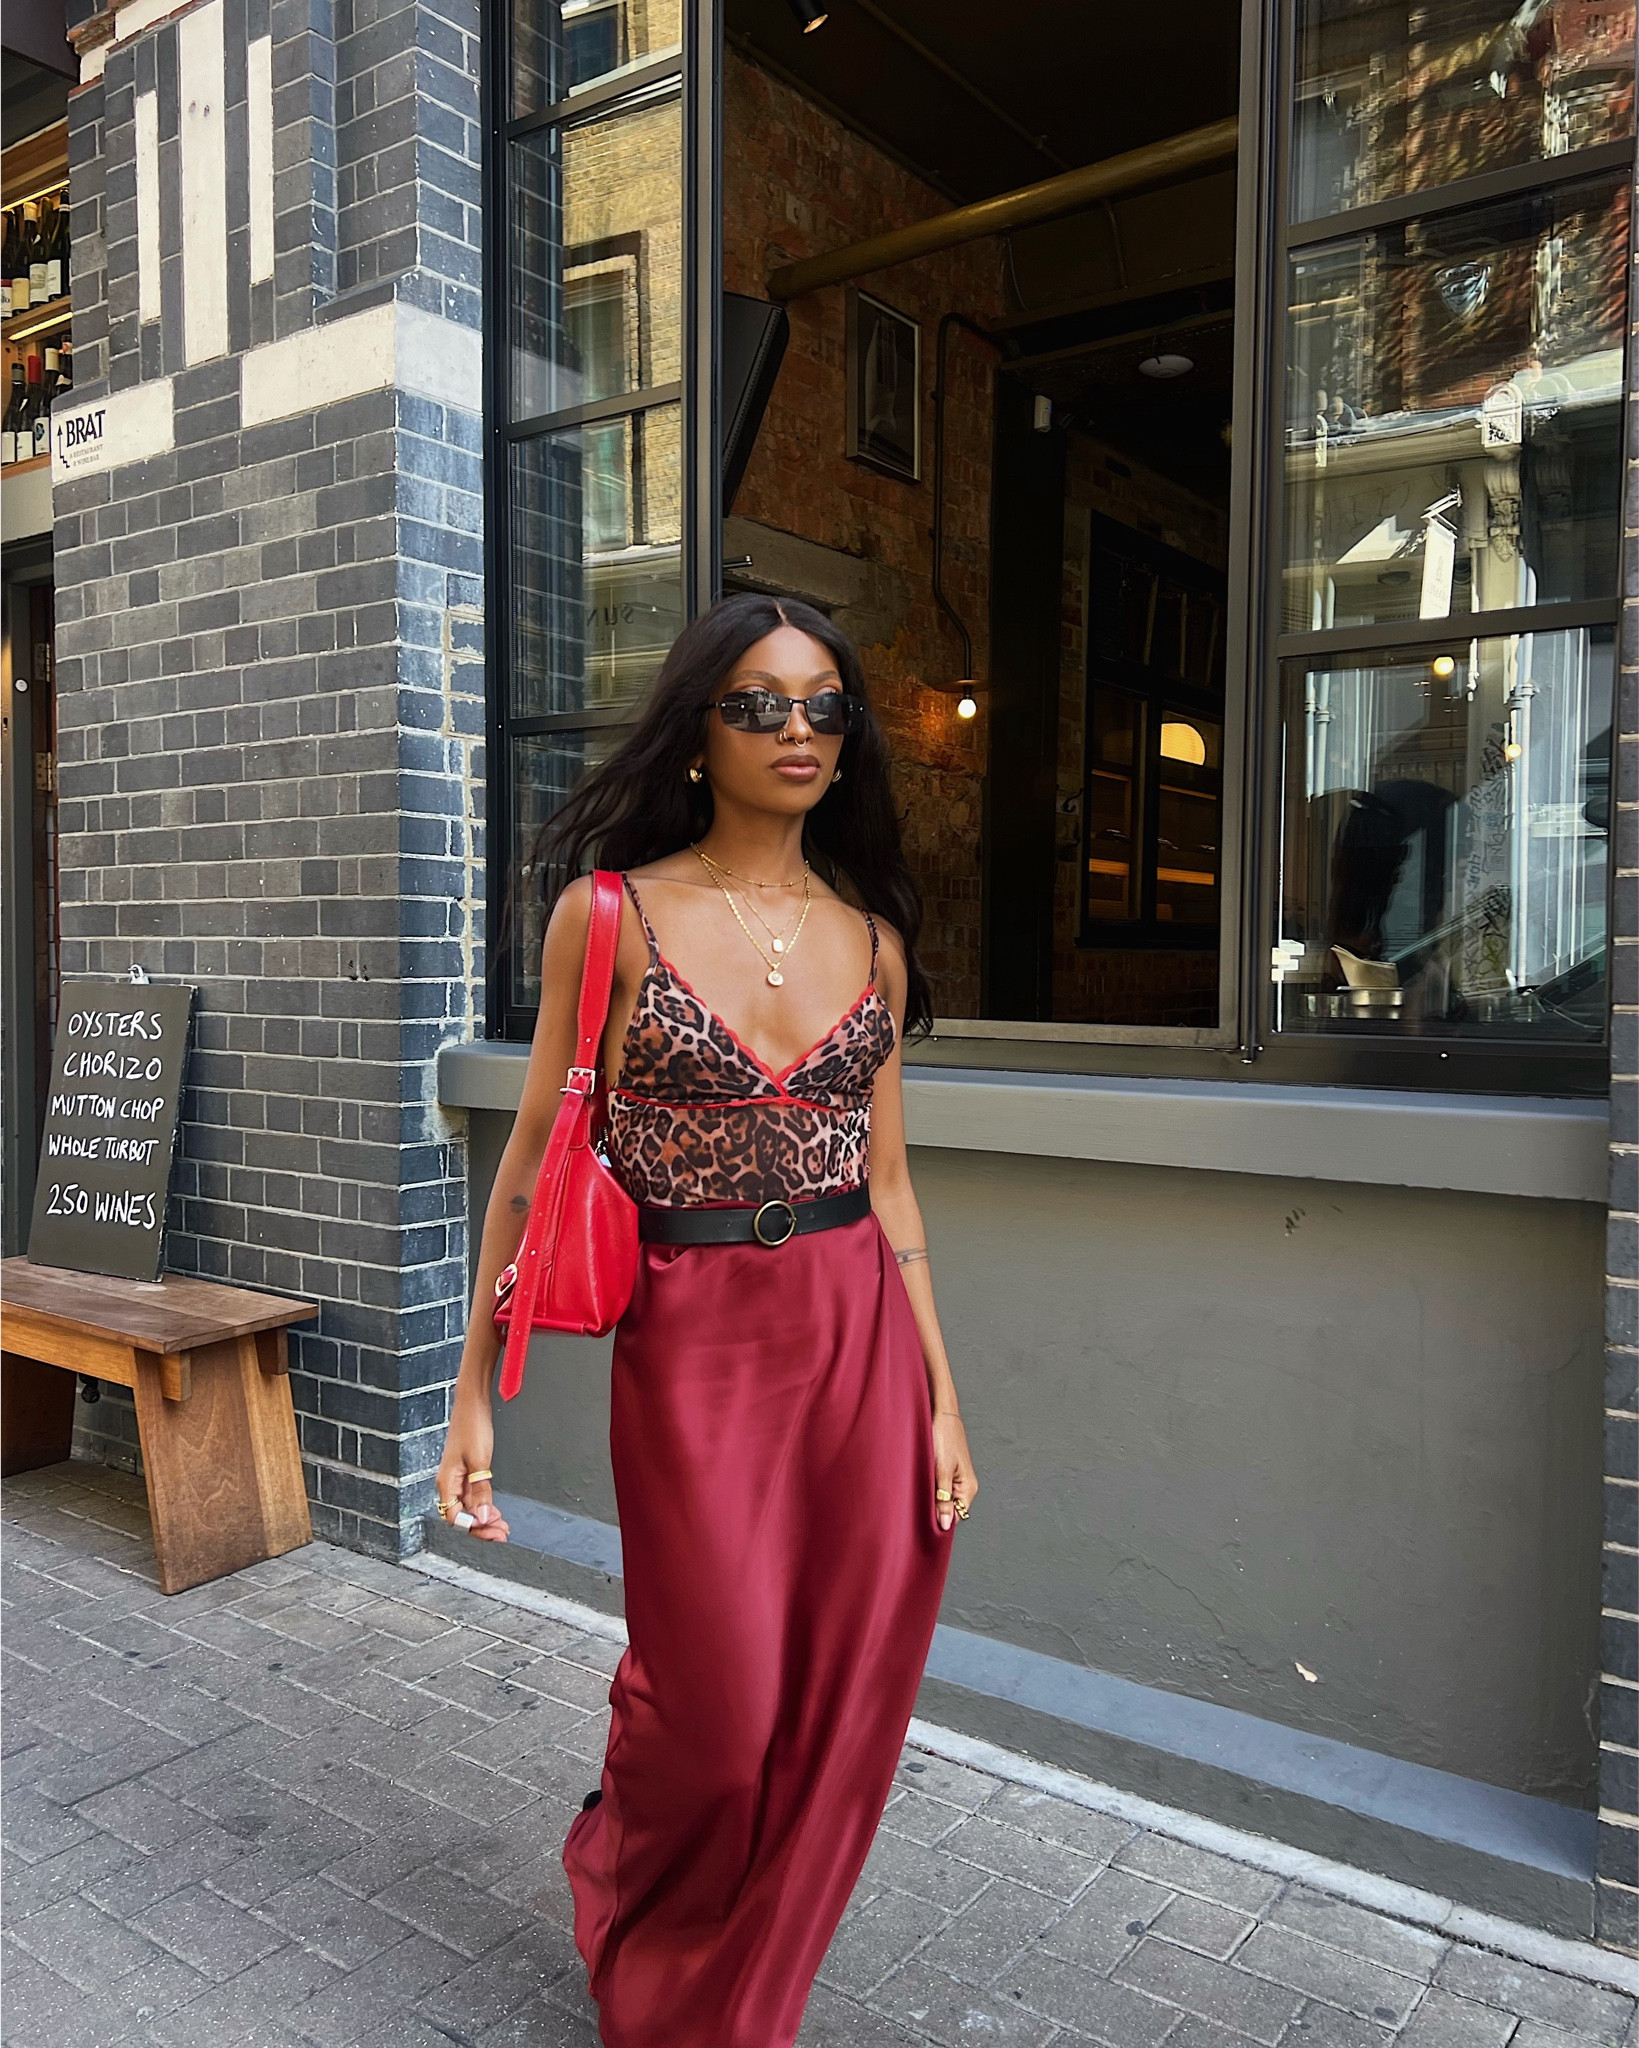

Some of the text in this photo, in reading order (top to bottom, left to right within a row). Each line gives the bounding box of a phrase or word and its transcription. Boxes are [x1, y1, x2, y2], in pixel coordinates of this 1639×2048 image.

[66, 410, 106, 447] BRAT
[67, 1010, 163, 1040] OYSTERS
[63, 1050, 163, 1081] CHORIZO
[51, 1094, 164, 1122] MUTTON CHOP
[48, 1133, 159, 1166] WHOLE TURBOT
[46, 1183, 156, 1230] 250 WINES
